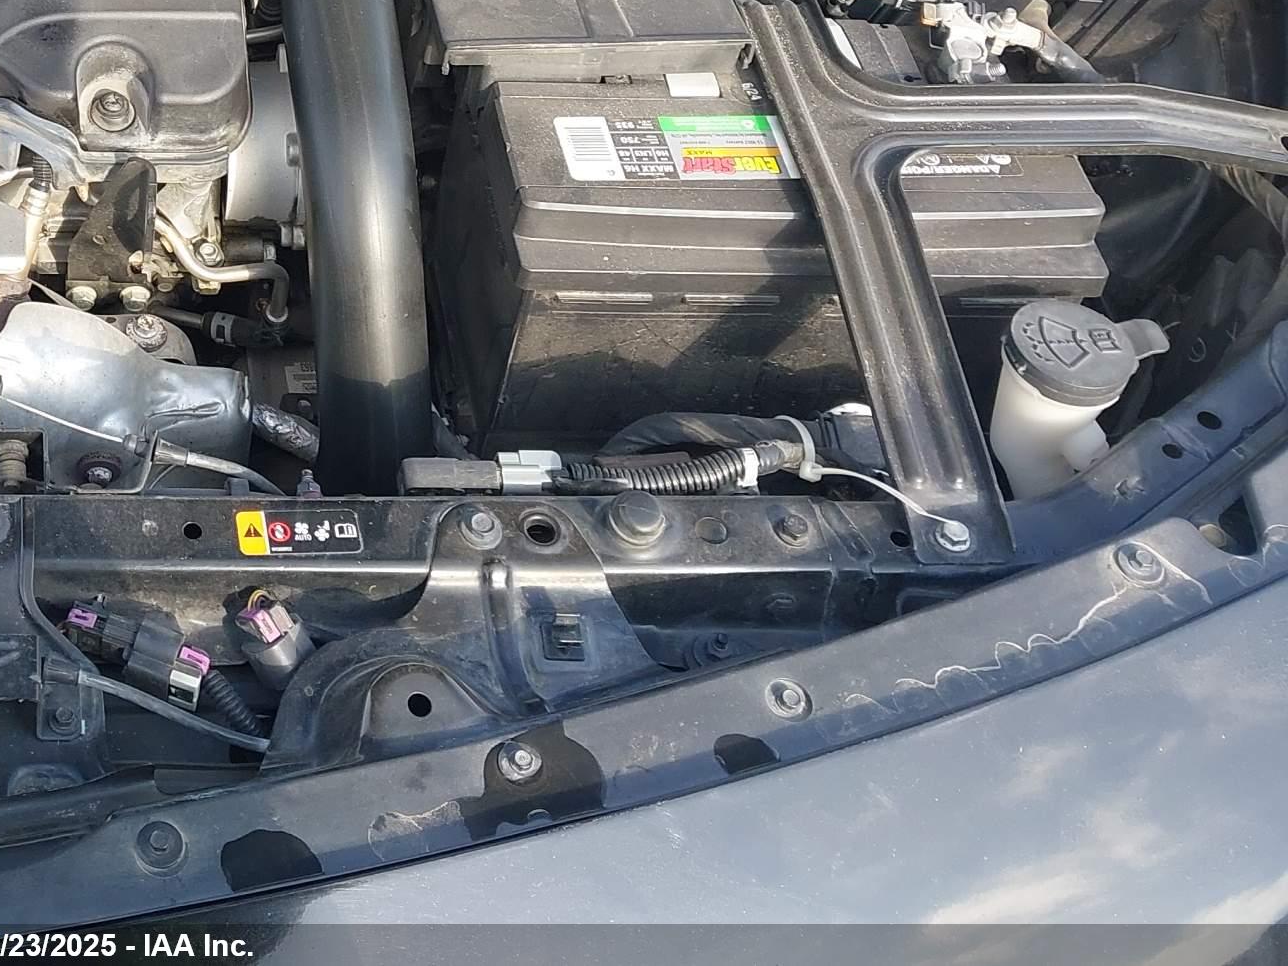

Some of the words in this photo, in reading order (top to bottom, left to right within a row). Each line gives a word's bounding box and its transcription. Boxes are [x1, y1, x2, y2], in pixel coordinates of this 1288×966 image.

[640, 164, 675, 173] MAXX
[682, 156, 782, 175] EverStart
[294, 534, 312, 542] AUTO
